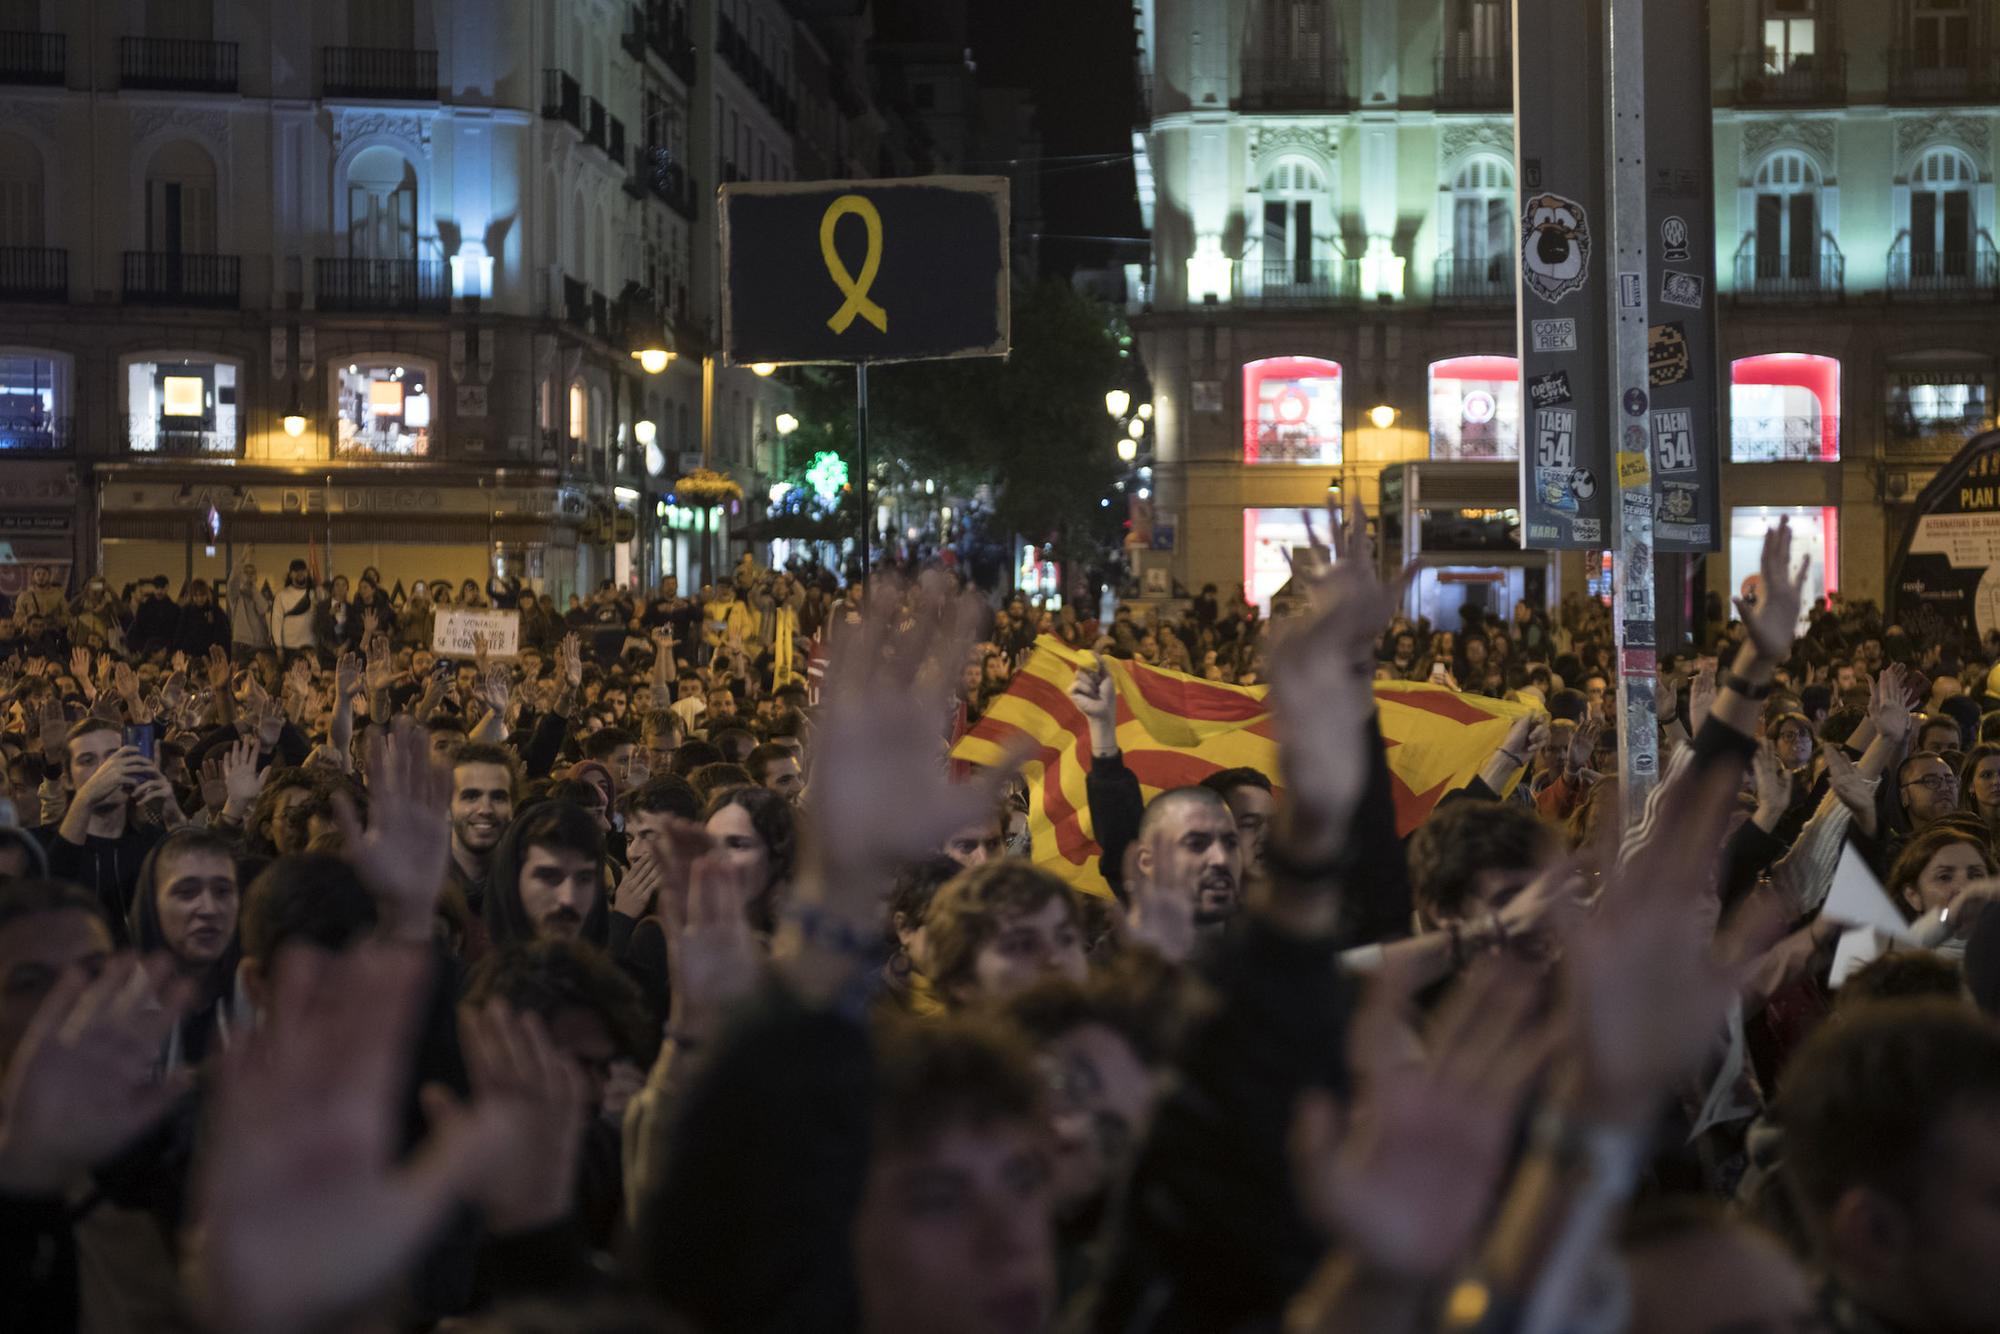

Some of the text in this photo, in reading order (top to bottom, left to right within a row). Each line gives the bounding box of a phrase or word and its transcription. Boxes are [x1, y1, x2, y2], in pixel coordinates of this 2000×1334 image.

[1535, 322, 1572, 334] COMS
[1540, 411, 1572, 432] TAEM
[1655, 412, 1688, 432] TAEM
[1539, 431, 1571, 468] 54
[1658, 431, 1692, 469] 54
[281, 488, 322, 510] DE
[343, 489, 440, 510] DIEGO
[1961, 487, 1994, 508] PLAN
[1926, 518, 1970, 529] ALTERNATIVAS
[1972, 518, 1982, 528] DE
